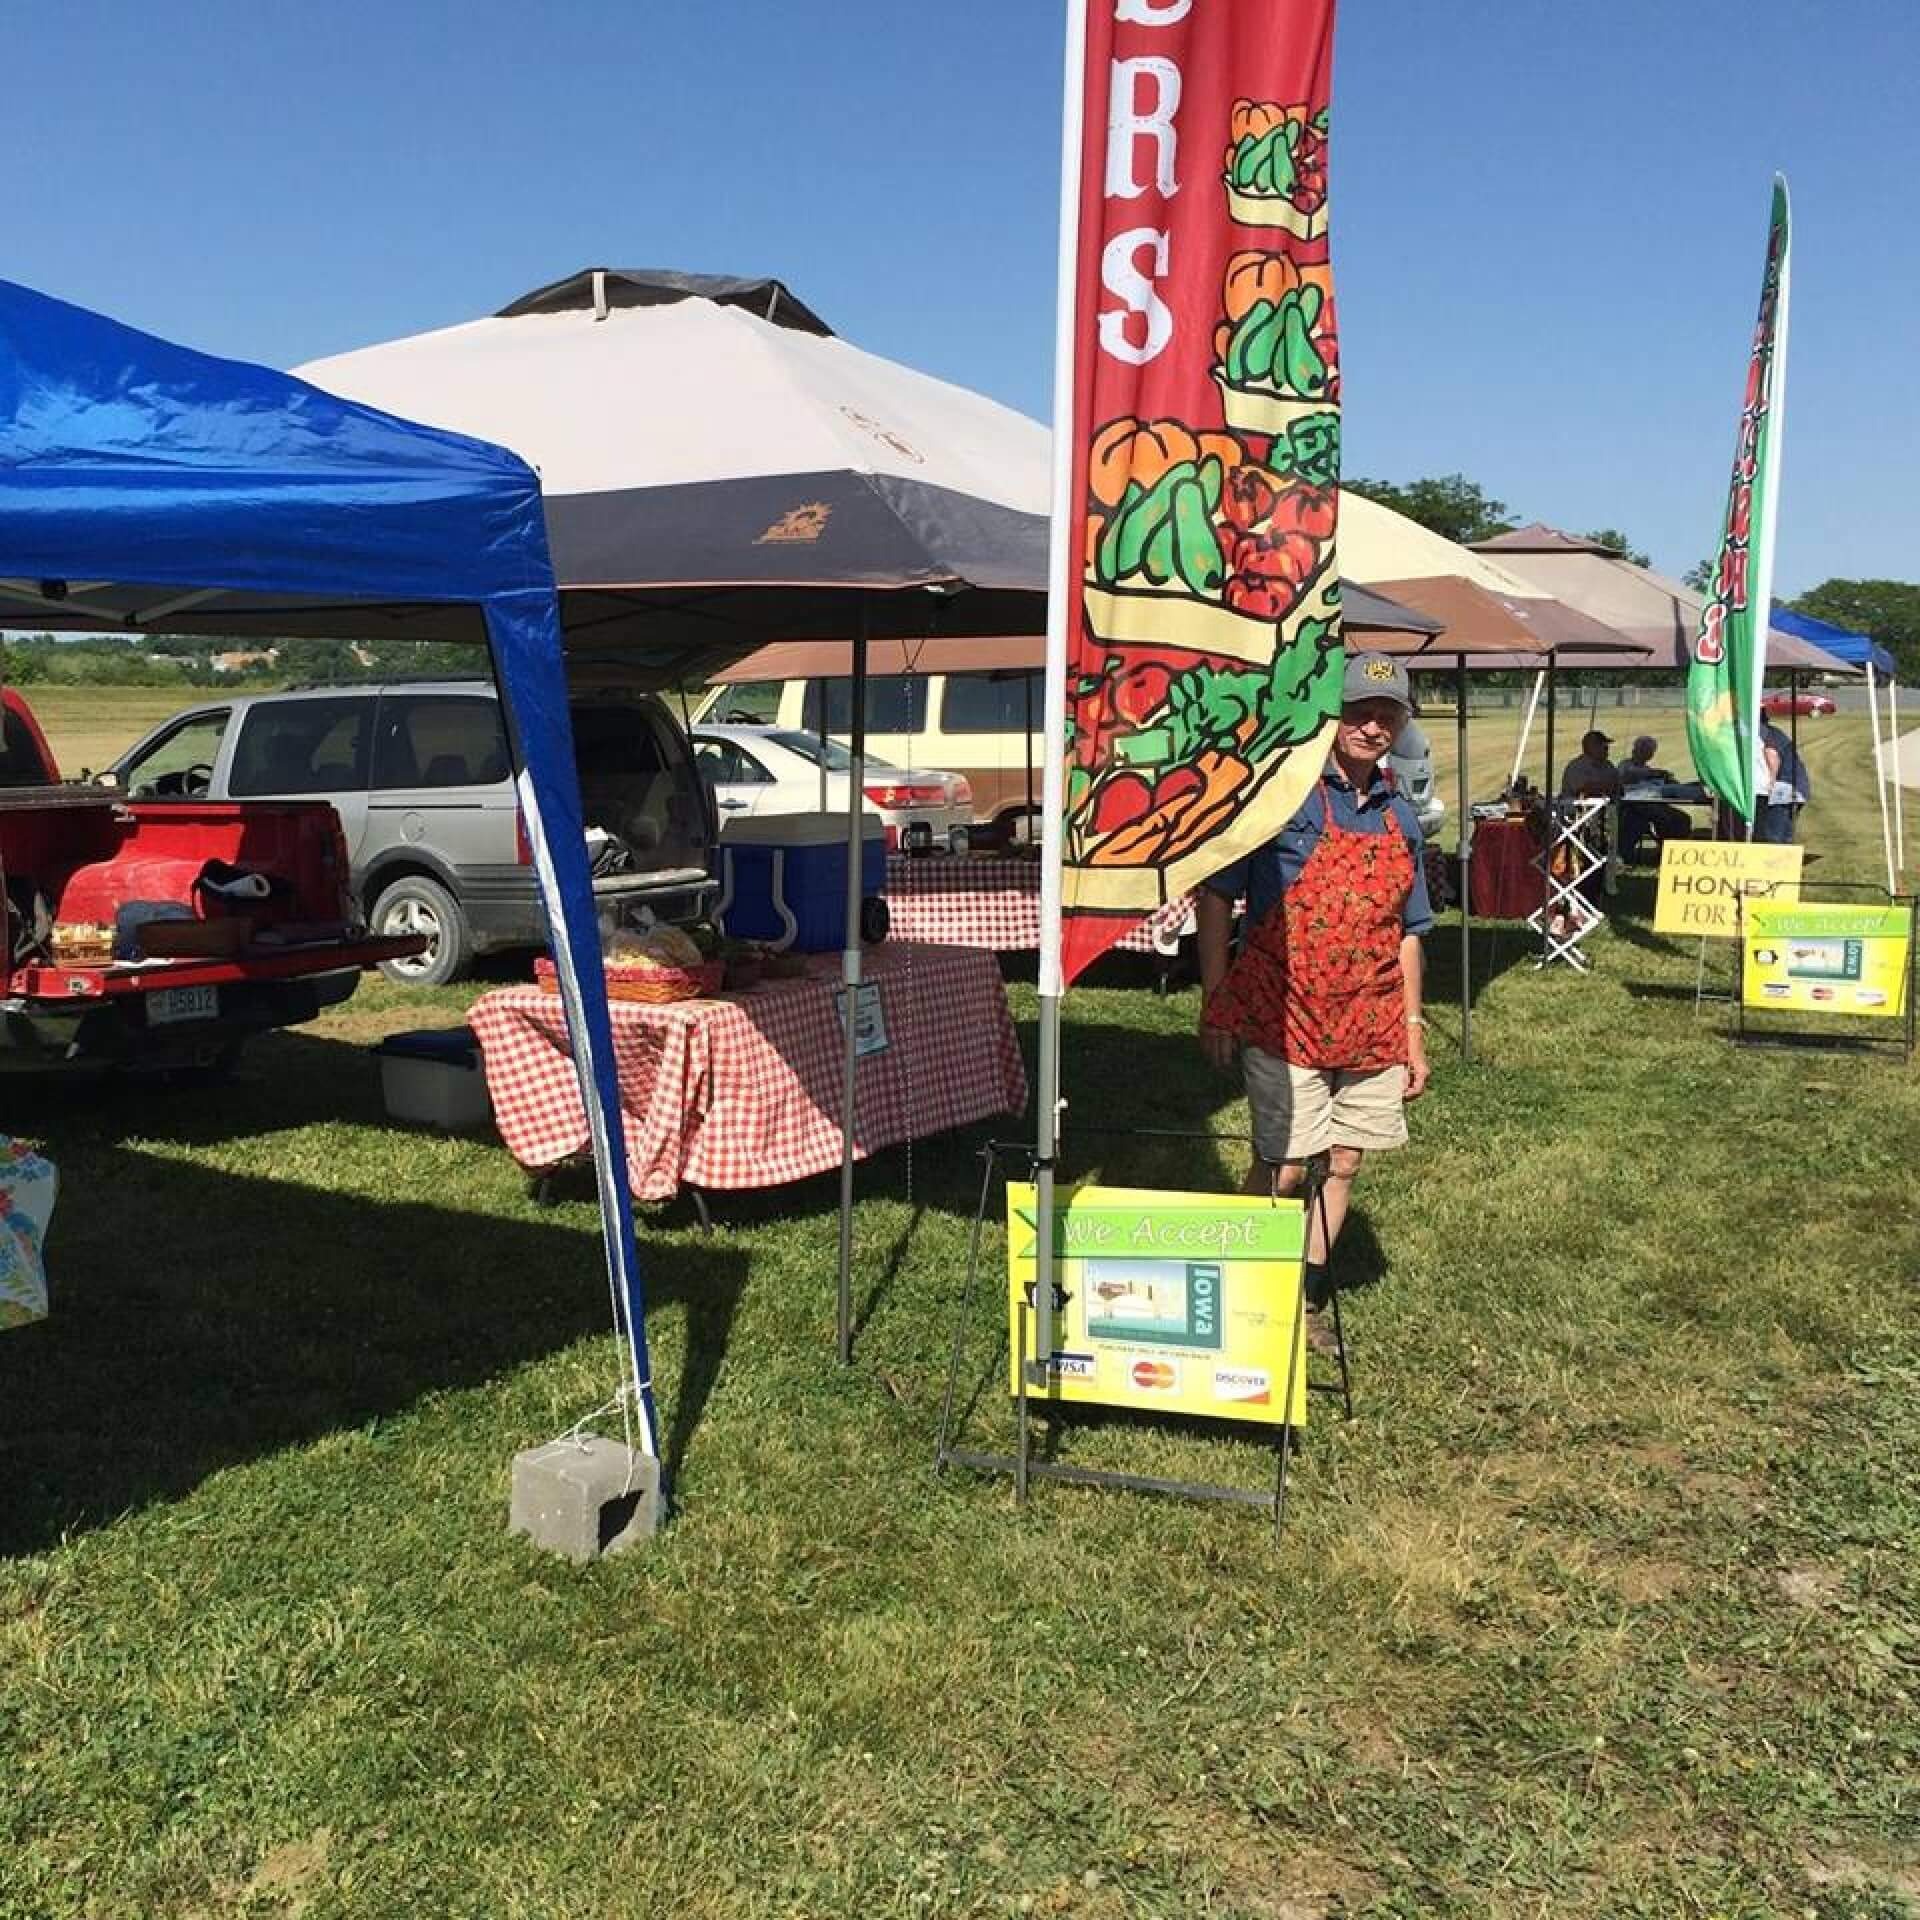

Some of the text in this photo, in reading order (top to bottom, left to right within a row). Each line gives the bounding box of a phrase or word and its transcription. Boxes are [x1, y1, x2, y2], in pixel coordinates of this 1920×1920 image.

[1097, 0, 1194, 366] RS
[1667, 847, 1744, 867] LOCAL
[1672, 874, 1779, 898] HONEY
[1681, 902, 1727, 926] FOR
[1063, 1214, 1264, 1257] We Accept
[1193, 1268, 1217, 1335] Iowa
[1214, 1372, 1267, 1388] DISCOVER
